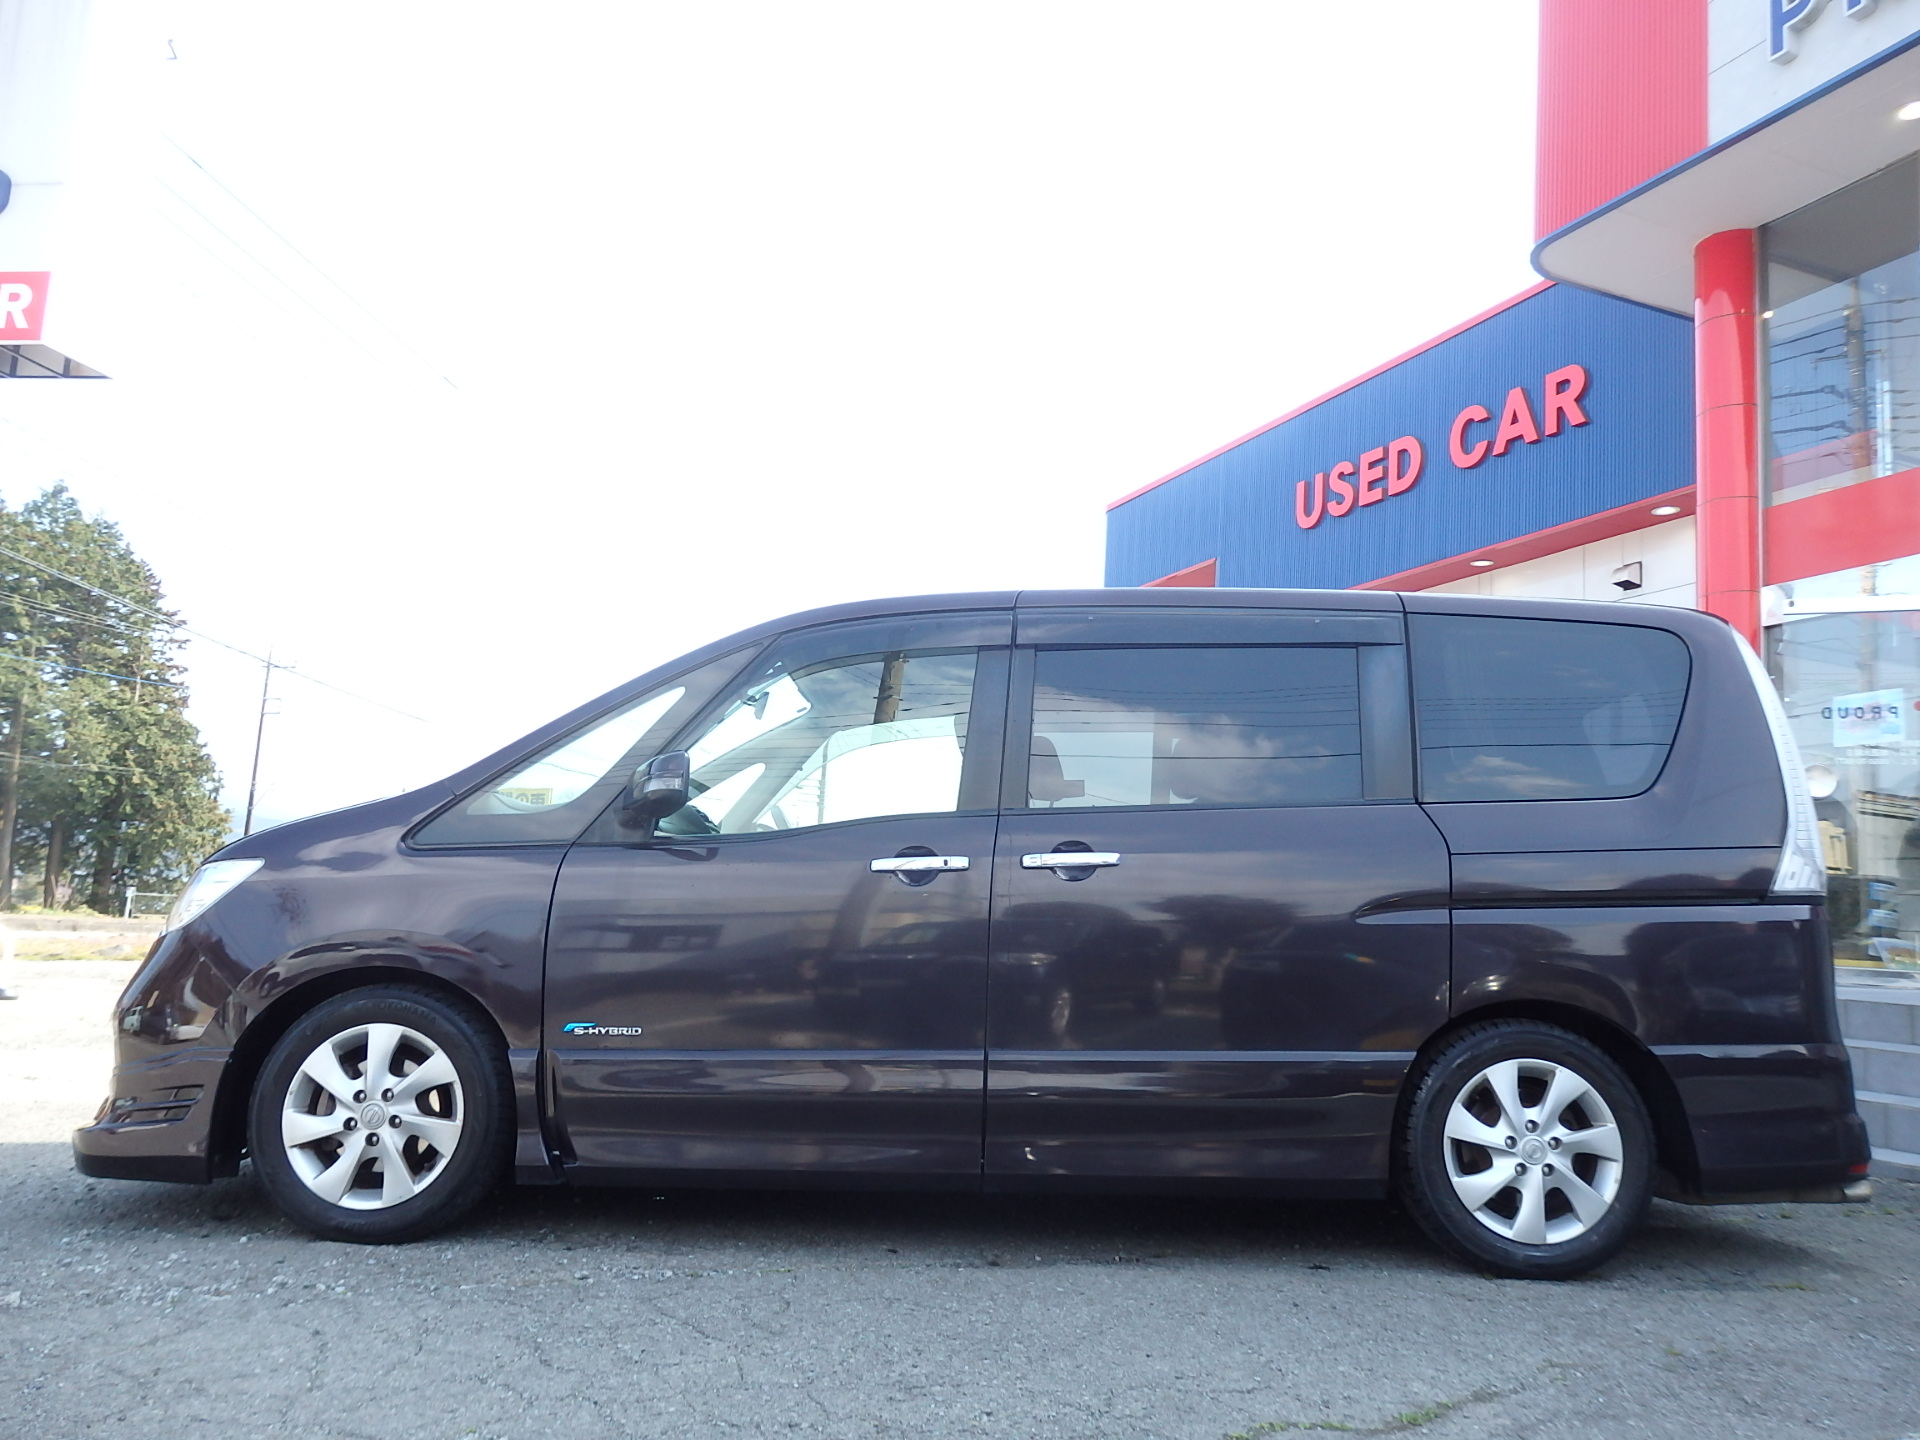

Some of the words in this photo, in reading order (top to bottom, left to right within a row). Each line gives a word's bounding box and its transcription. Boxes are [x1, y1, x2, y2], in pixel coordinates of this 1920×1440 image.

[0, 283, 34, 329] R
[1295, 434, 1423, 530] USED
[1449, 364, 1591, 469] CAR
[573, 1027, 642, 1036] S-HYBRID
